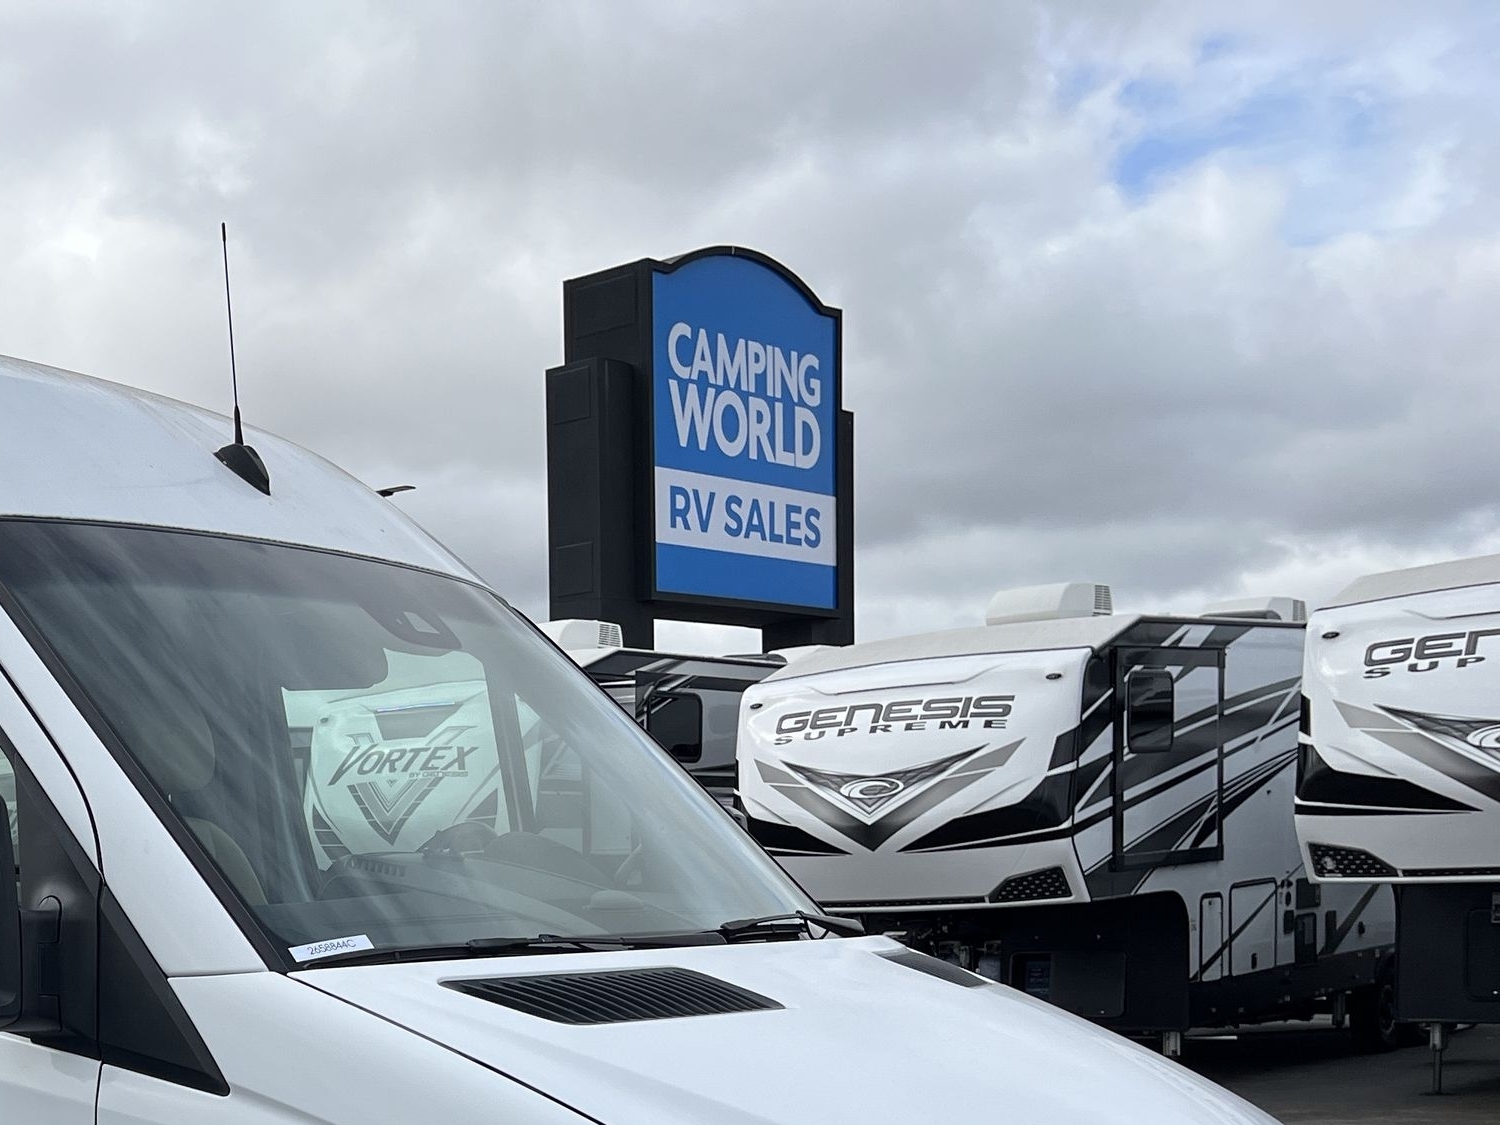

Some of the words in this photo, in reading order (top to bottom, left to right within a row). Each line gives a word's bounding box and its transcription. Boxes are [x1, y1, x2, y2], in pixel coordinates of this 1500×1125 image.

[667, 321, 821, 408] CAMPING
[668, 379, 821, 470] WORLD
[669, 486, 715, 533] RV
[724, 494, 821, 549] SALES
[774, 719, 1008, 746] SUPREME
[776, 695, 1016, 735] GENESIS
[327, 743, 479, 786] VORTEX
